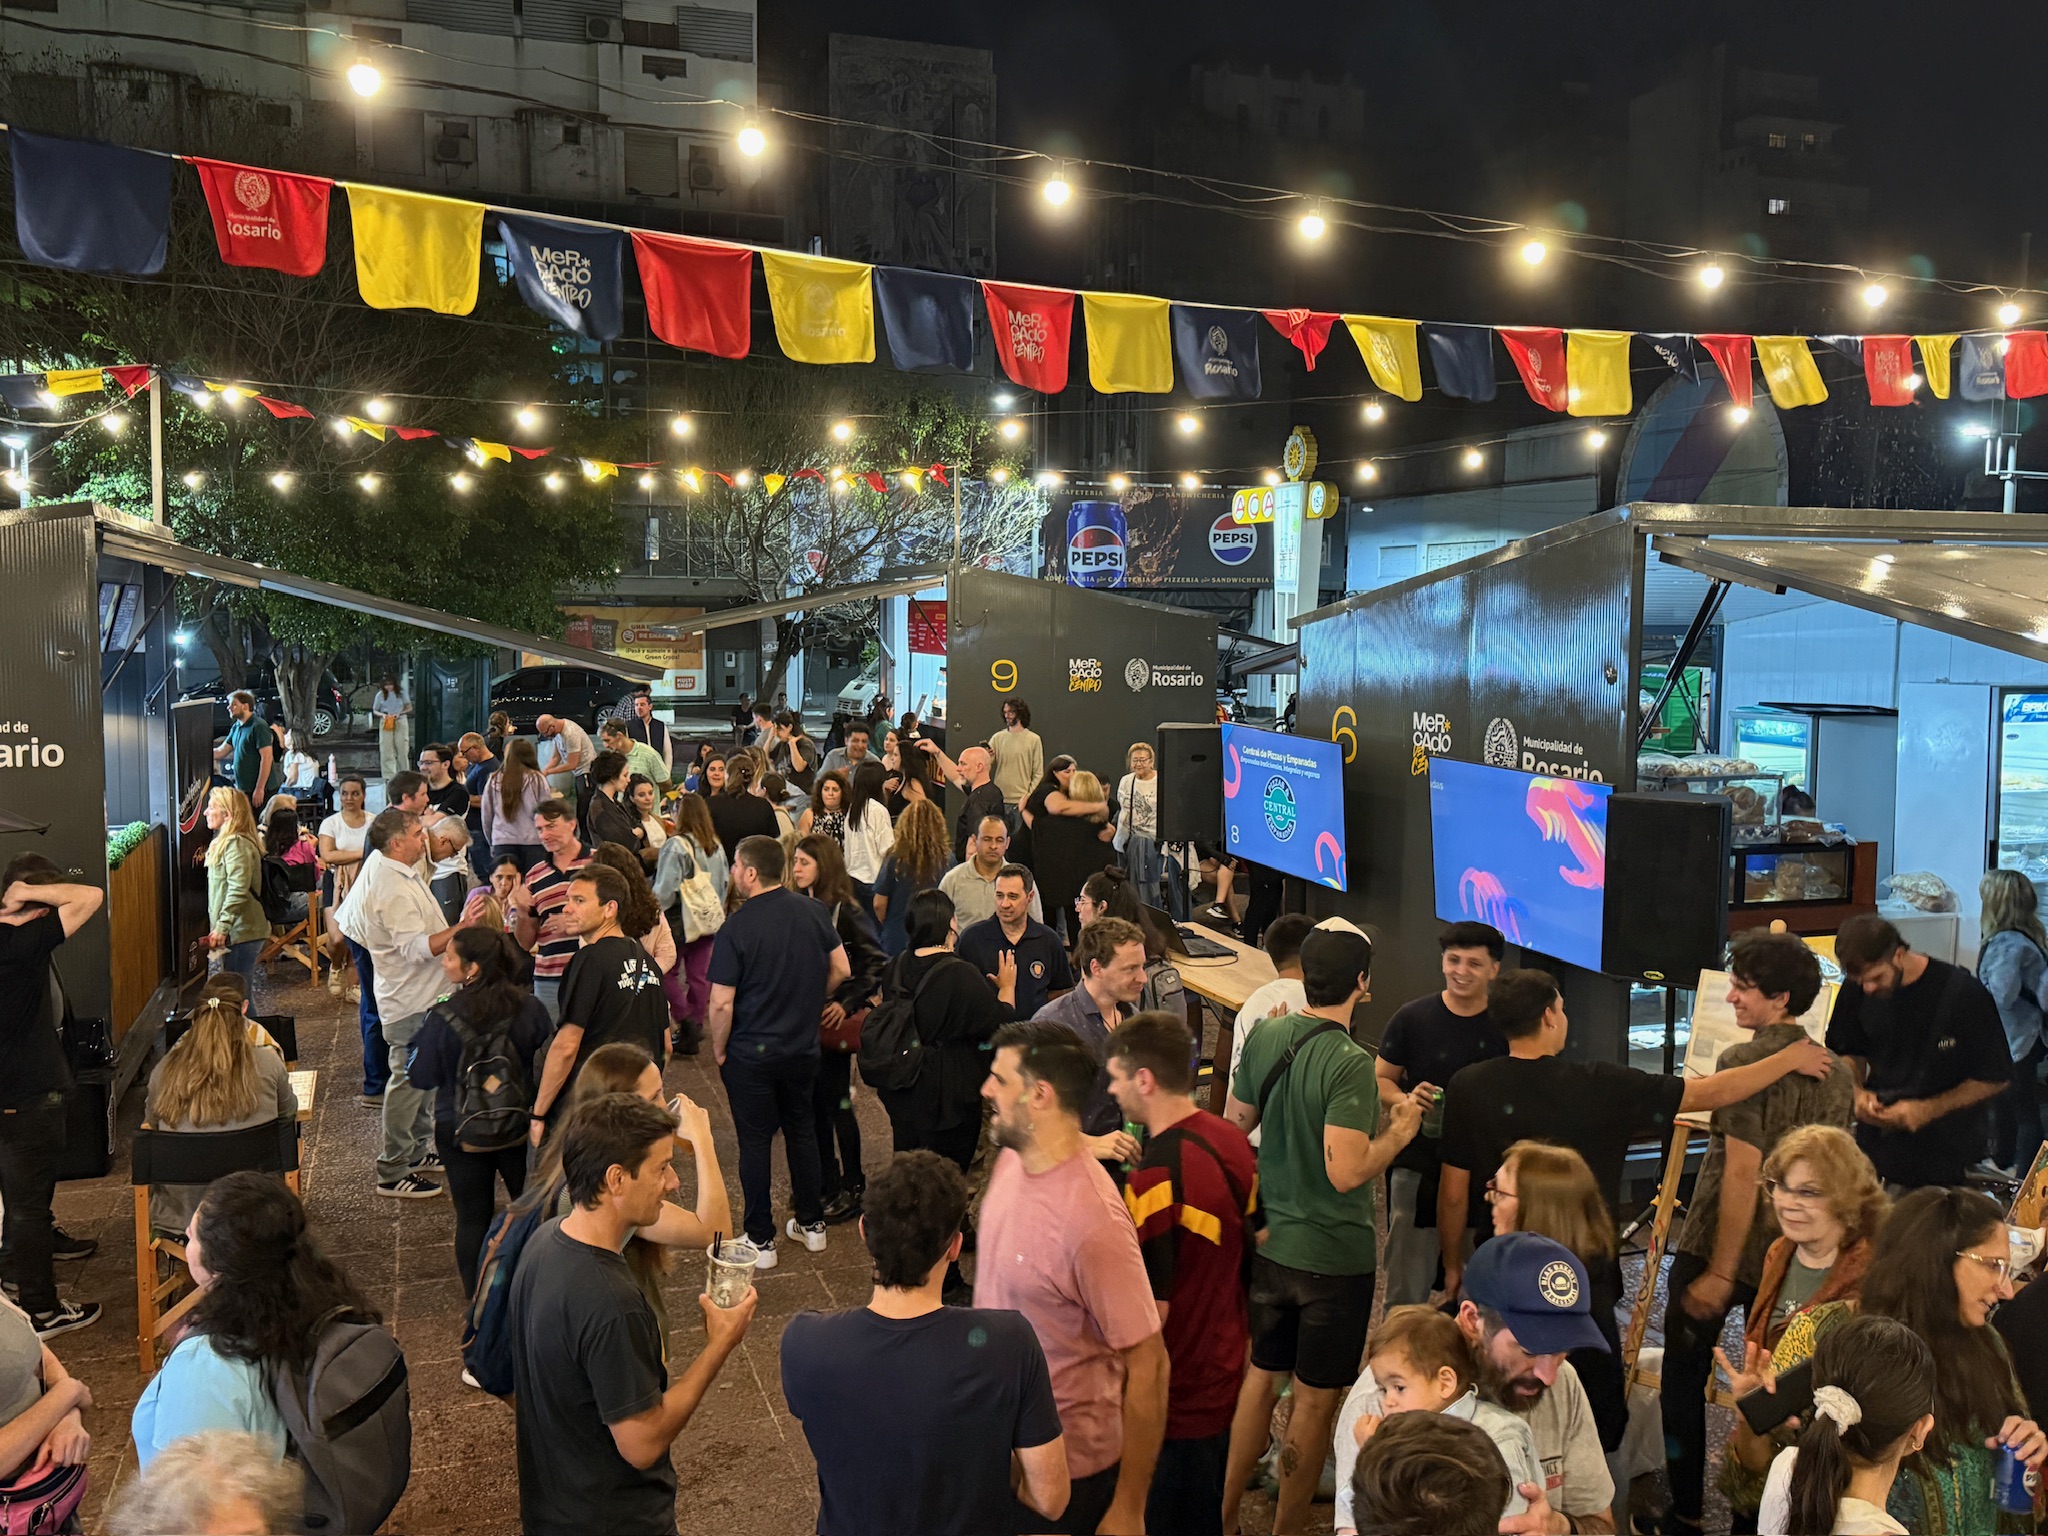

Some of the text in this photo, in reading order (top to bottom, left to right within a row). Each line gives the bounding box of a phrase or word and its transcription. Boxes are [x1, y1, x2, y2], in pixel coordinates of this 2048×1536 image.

[1213, 533, 1254, 544] PEPSI
[1071, 551, 1122, 567] PEPSI
[990, 659, 1019, 692] 9
[1152, 671, 1204, 687] Rosario
[1068, 678, 1103, 692] CENTRO
[13, 721, 29, 733] de
[1331, 705, 1358, 764] 6
[1523, 735, 1584, 755] Municipalidad de
[1242, 745, 1260, 757] Central
[1260, 749, 1267, 758] de
[1267, 750, 1283, 762] Pizzas
[1287, 753, 1317, 769] Empanadas
[1263, 800, 1296, 818] CENTRAL
[1230, 825, 1240, 844] 8
